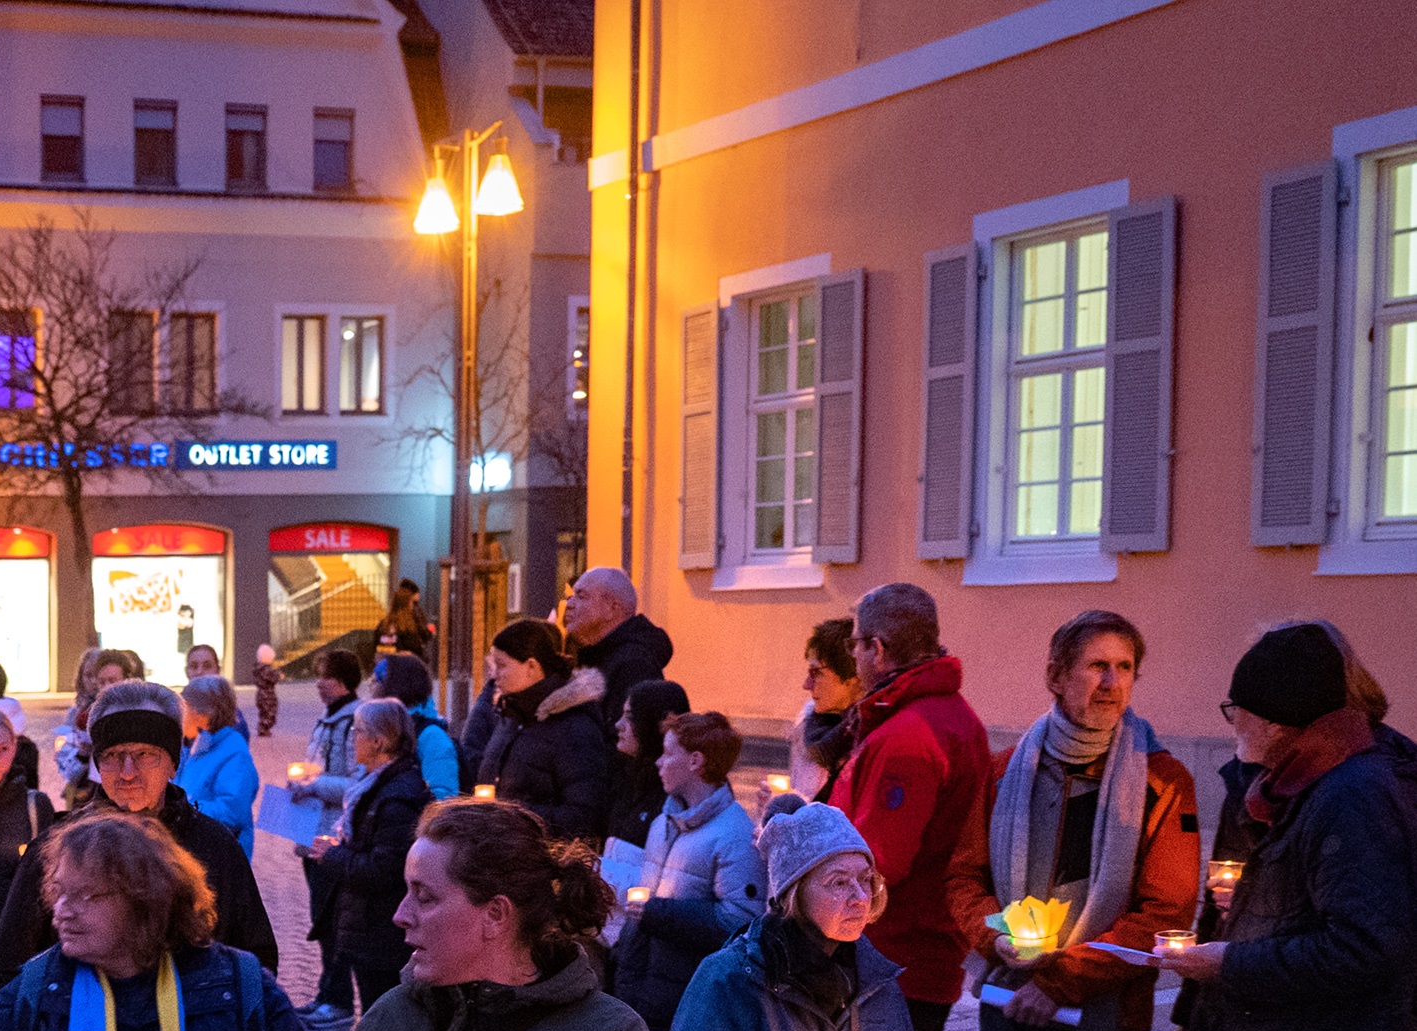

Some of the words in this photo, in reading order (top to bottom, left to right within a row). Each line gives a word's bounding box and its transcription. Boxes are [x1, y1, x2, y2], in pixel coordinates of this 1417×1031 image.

[189, 443, 263, 465] OUTLET
[269, 443, 330, 465] STORE
[134, 531, 182, 550] SALE
[305, 529, 351, 549] SALE
